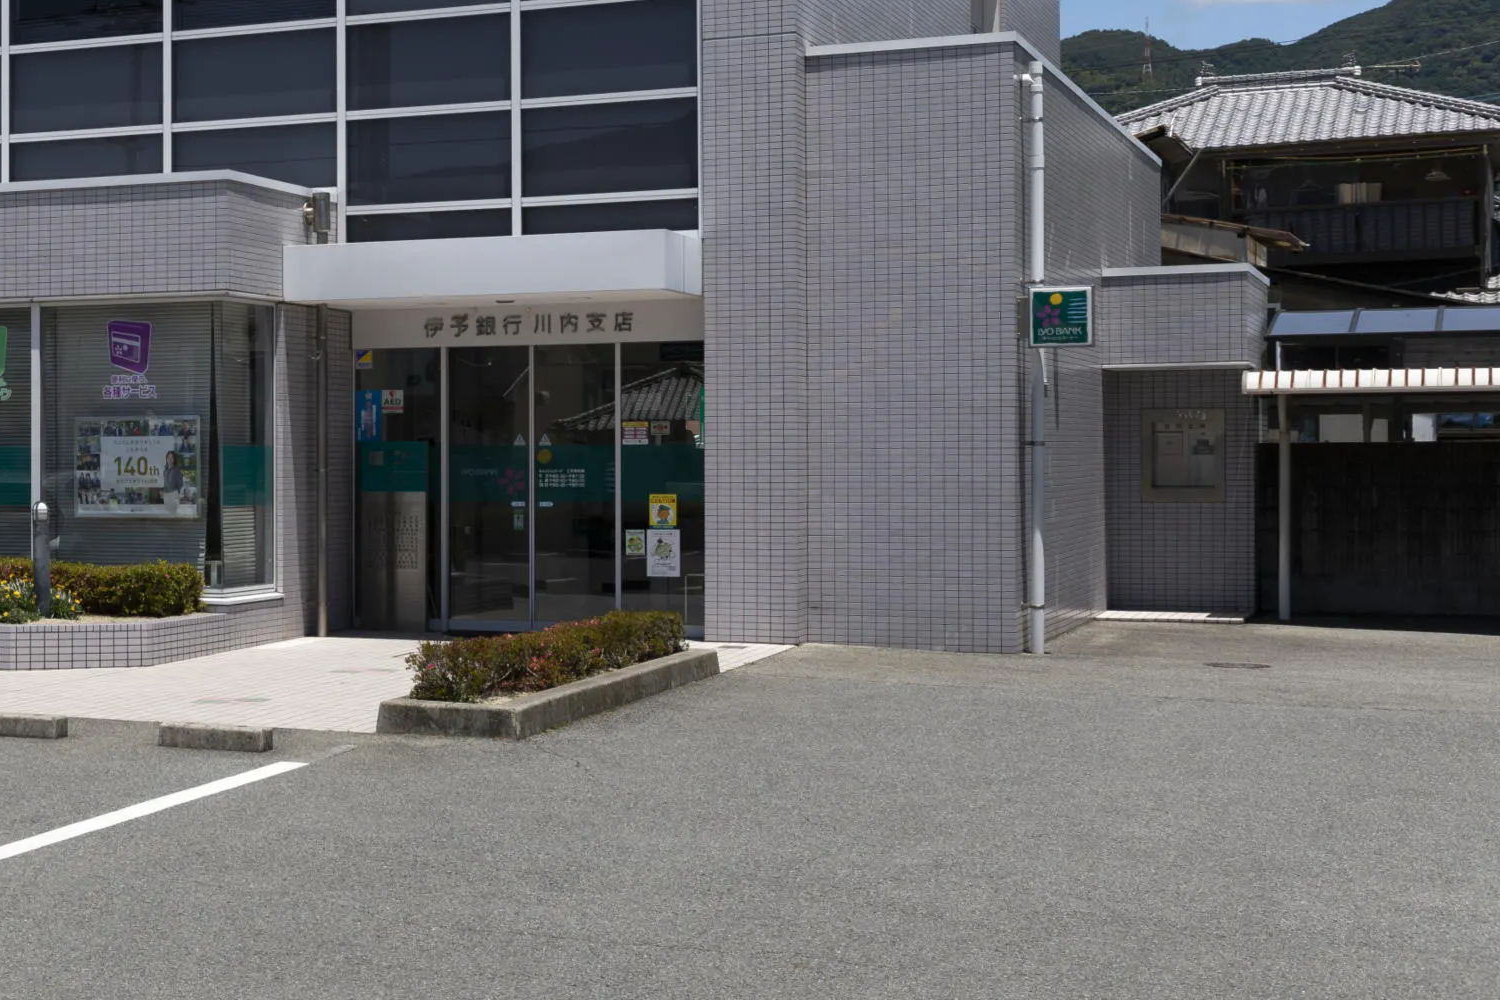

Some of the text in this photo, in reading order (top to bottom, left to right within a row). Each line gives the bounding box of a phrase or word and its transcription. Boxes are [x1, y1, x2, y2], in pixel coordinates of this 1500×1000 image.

[423, 311, 634, 339] 伊予銀行 川内支店
[1055, 326, 1083, 336] BANK
[114, 455, 159, 476] 140th
